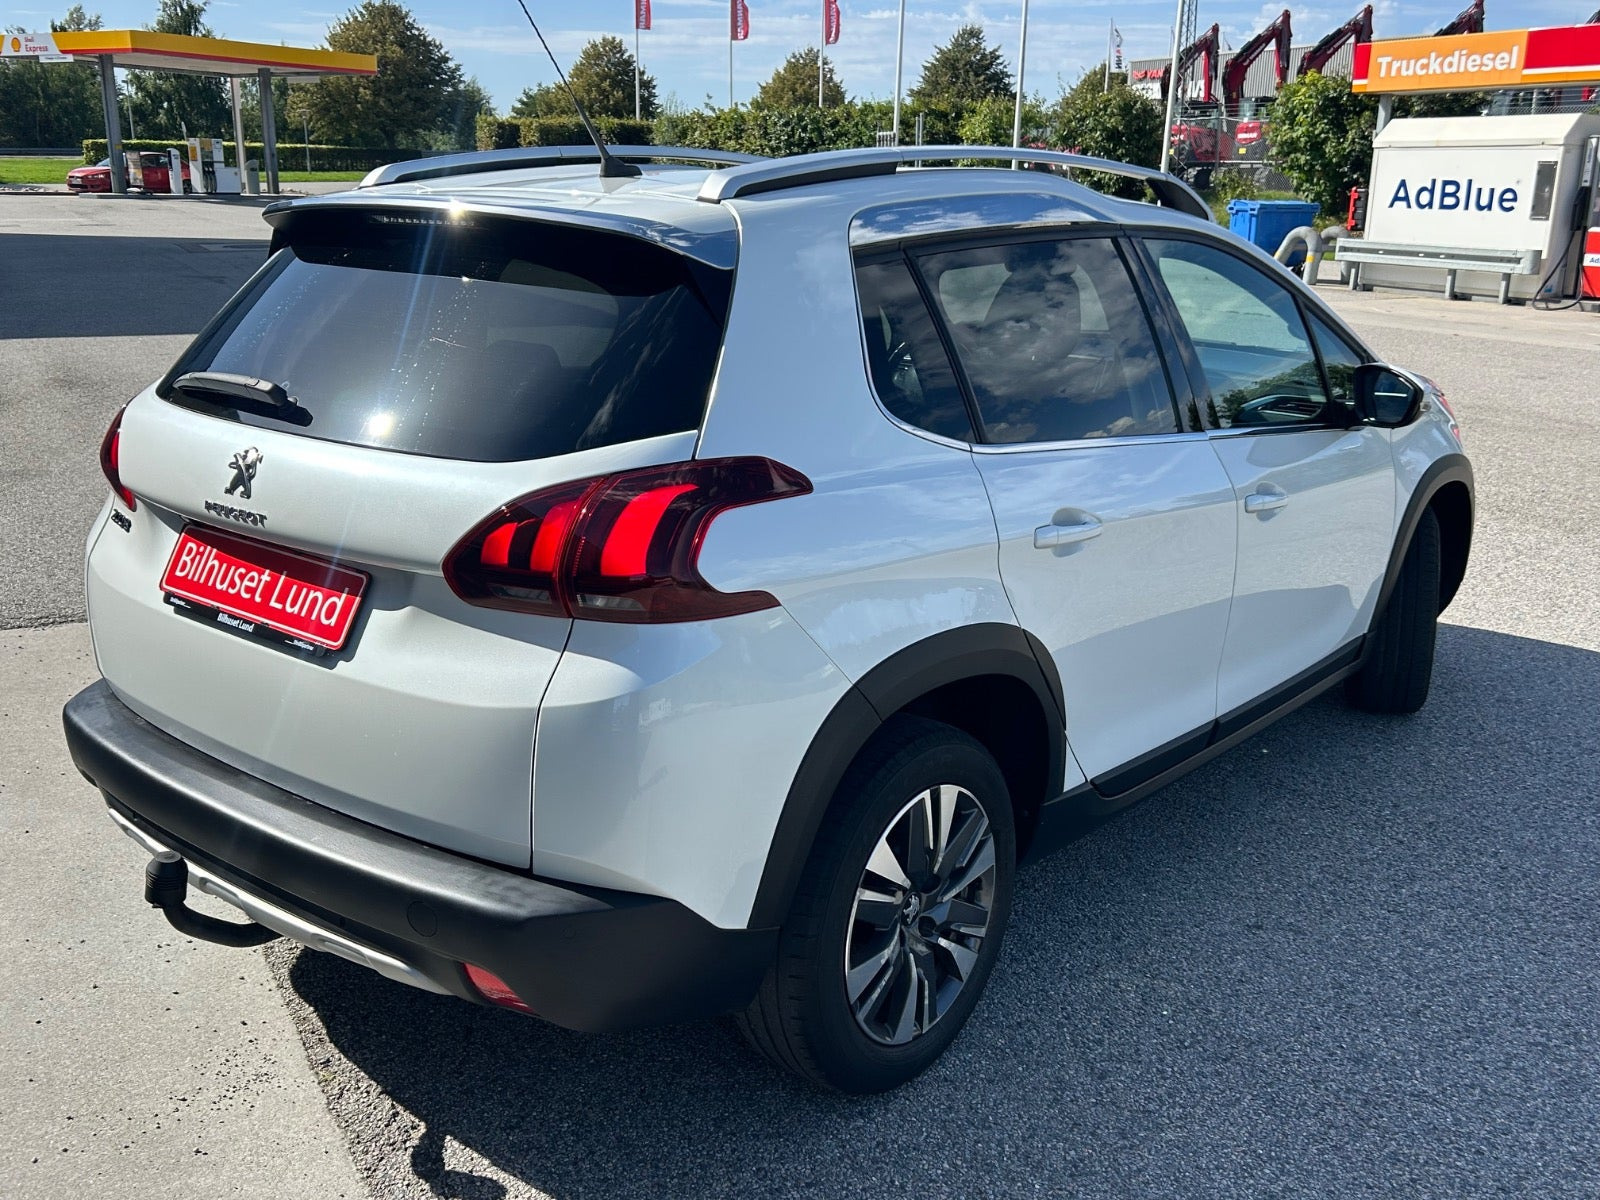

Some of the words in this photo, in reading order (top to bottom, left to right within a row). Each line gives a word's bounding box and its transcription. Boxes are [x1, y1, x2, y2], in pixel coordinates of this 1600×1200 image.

[25, 44, 49, 54] Express
[1376, 45, 1520, 78] Truckdiesel
[1388, 178, 1518, 213] AdBlue
[204, 500, 268, 528] PEUGEOT
[174, 541, 272, 603] Bilhuset
[268, 570, 350, 627] Lund
[216, 612, 241, 628] Bilhuset
[238, 619, 255, 632] Lund
